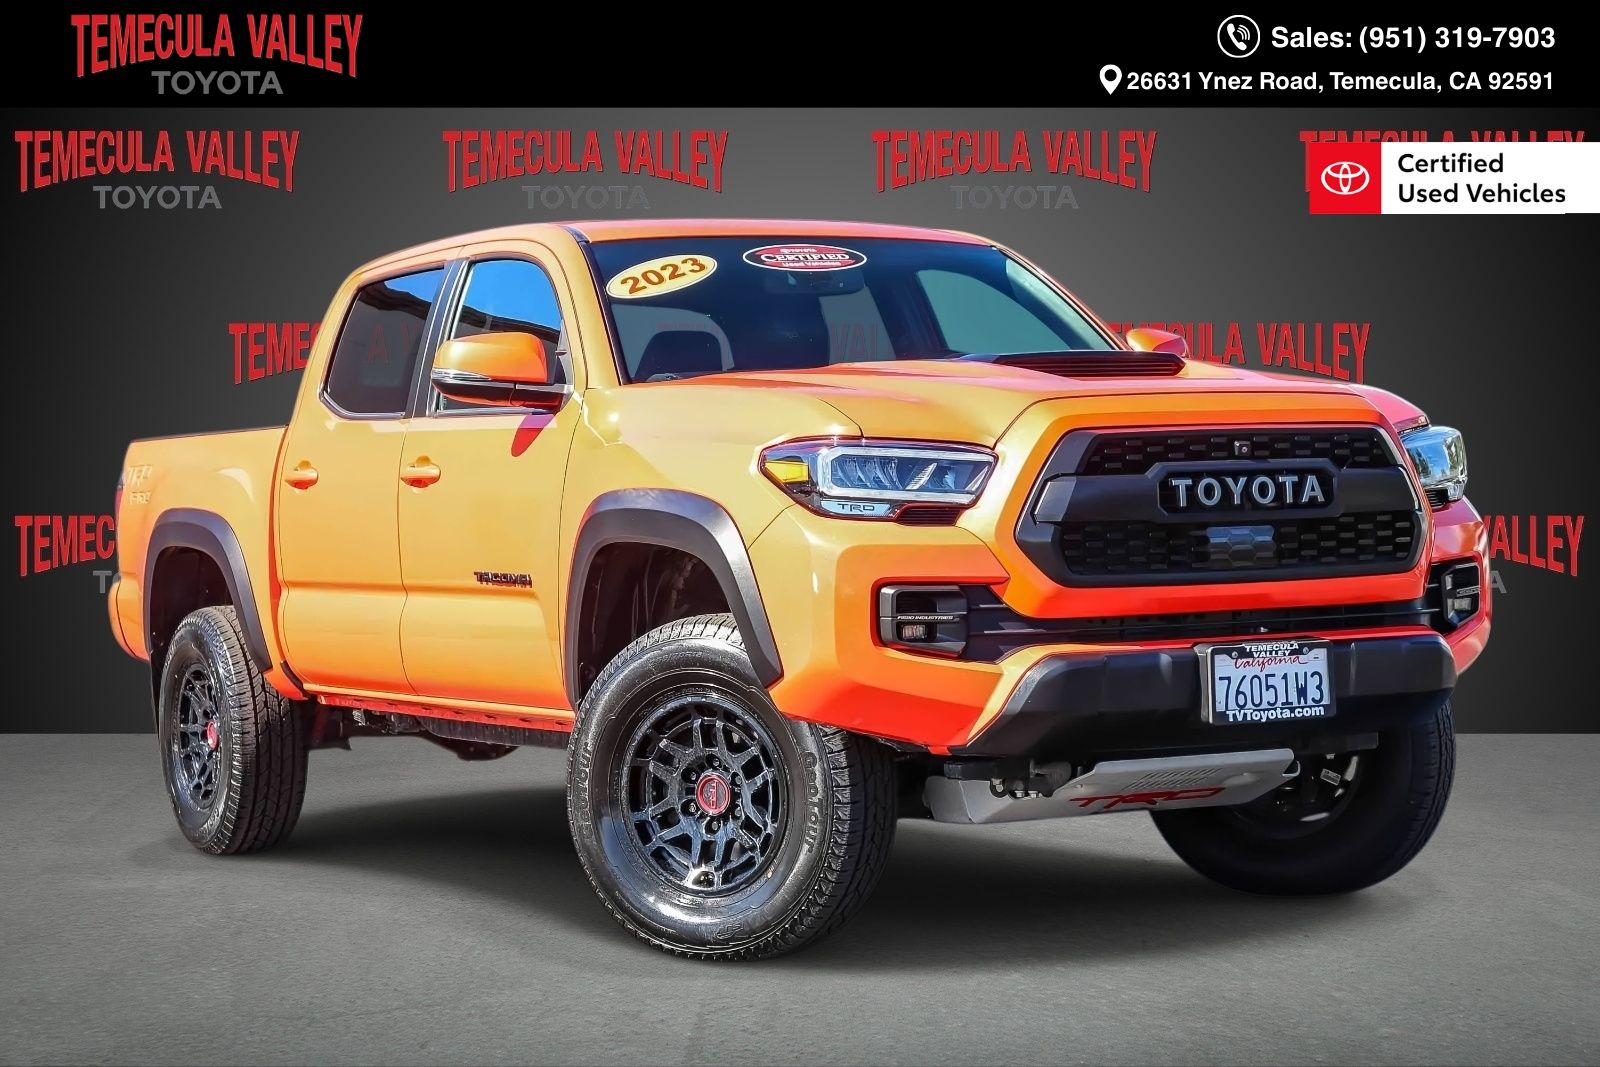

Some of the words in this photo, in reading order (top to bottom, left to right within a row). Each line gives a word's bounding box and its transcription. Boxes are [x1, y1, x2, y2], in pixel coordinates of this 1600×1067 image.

[14, 130, 175, 193] TEMECULA
[187, 130, 299, 192] VALLEY
[442, 130, 603, 193] TEMECULA
[616, 130, 728, 192] VALLEY
[871, 130, 1031, 193] TEMECULA
[1043, 130, 1157, 192] VALLEY
[93, 185, 222, 209] TOYOTA
[521, 185, 652, 209] TOYOTA
[949, 185, 1080, 209] TOYOTA
[620, 257, 706, 294] 2023
[1256, 323, 1370, 384] VALLEY
[1170, 474, 1325, 508] TOYOTA
[837, 503, 875, 513] TRD
[1244, 642, 1299, 652] TEMECULA
[1252, 650, 1291, 658] VALLEY
[1234, 656, 1309, 673] California
[1218, 671, 1324, 710] 76051W3
[1226, 706, 1325, 722] TVToyota.com
